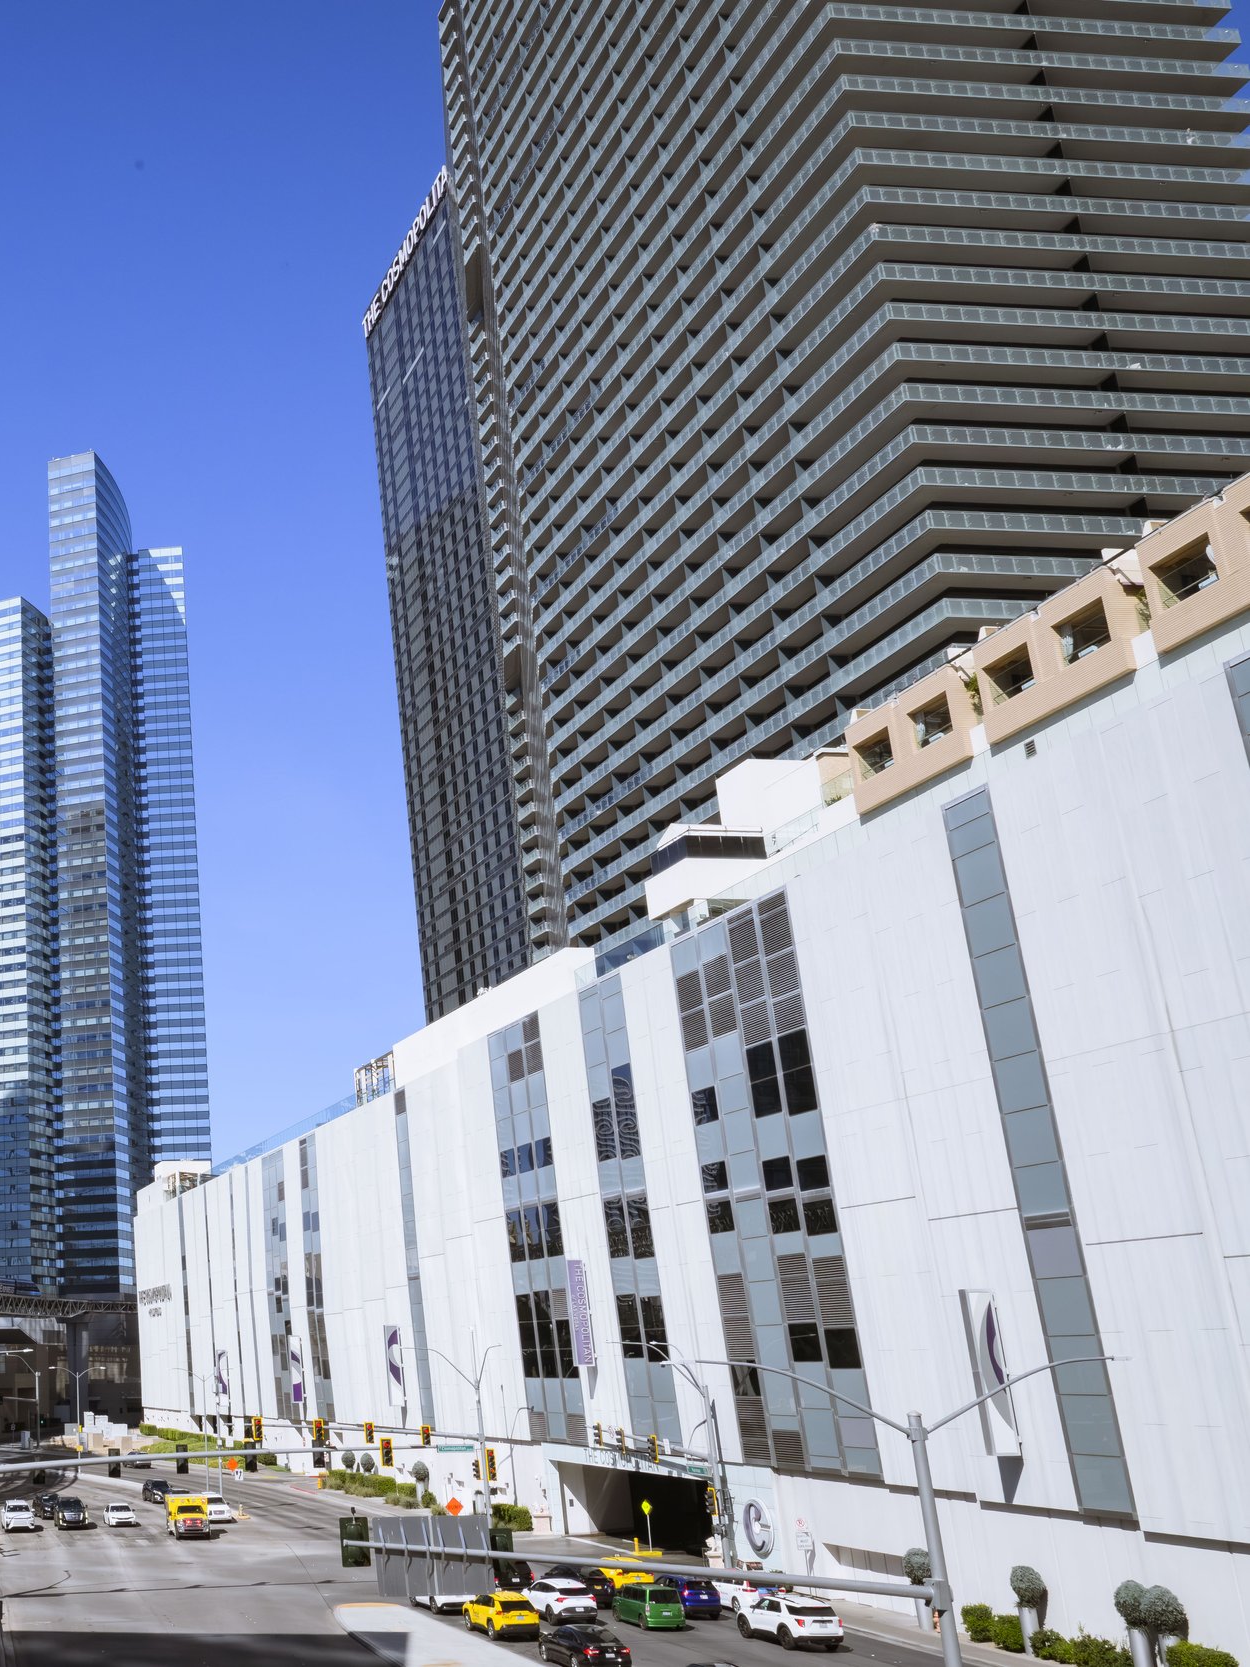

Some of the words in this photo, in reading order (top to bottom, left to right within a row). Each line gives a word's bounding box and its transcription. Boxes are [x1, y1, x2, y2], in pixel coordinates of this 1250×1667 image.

[362, 293, 383, 338] THE
[381, 165, 449, 303] COSMOPOLITA
[573, 1263, 583, 1282] THE
[576, 1285, 592, 1363] COSMOPOLITAN
